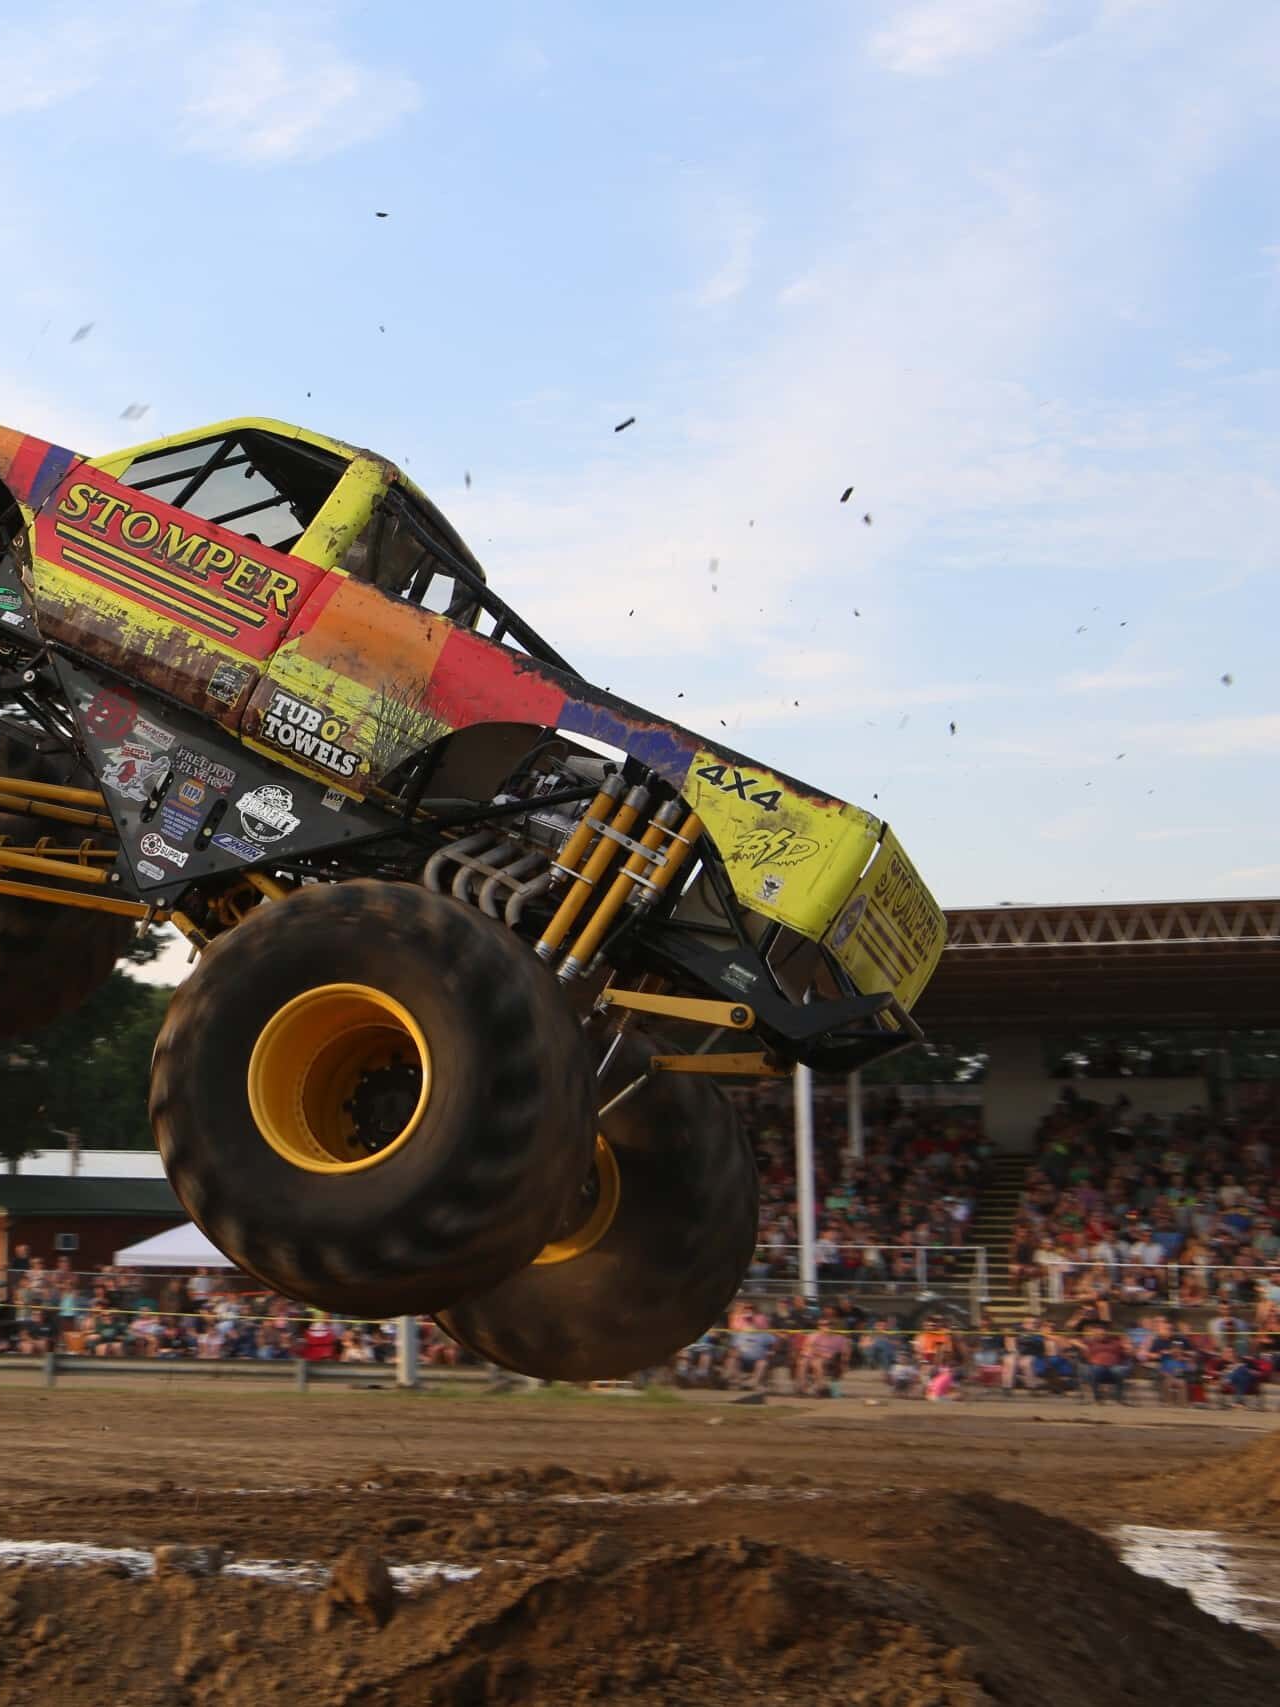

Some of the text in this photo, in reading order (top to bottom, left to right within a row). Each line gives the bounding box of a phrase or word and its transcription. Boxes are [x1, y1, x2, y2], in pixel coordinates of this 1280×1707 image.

[58, 483, 299, 619] STOMPER
[273, 693, 322, 732] TUB
[265, 713, 357, 776] TOWELS
[177, 747, 237, 783] FREEDOM
[182, 783, 203, 801] NAPA
[326, 789, 346, 803] WIX
[696, 764, 782, 811] 4X4
[160, 845, 188, 864] SUPPLY
